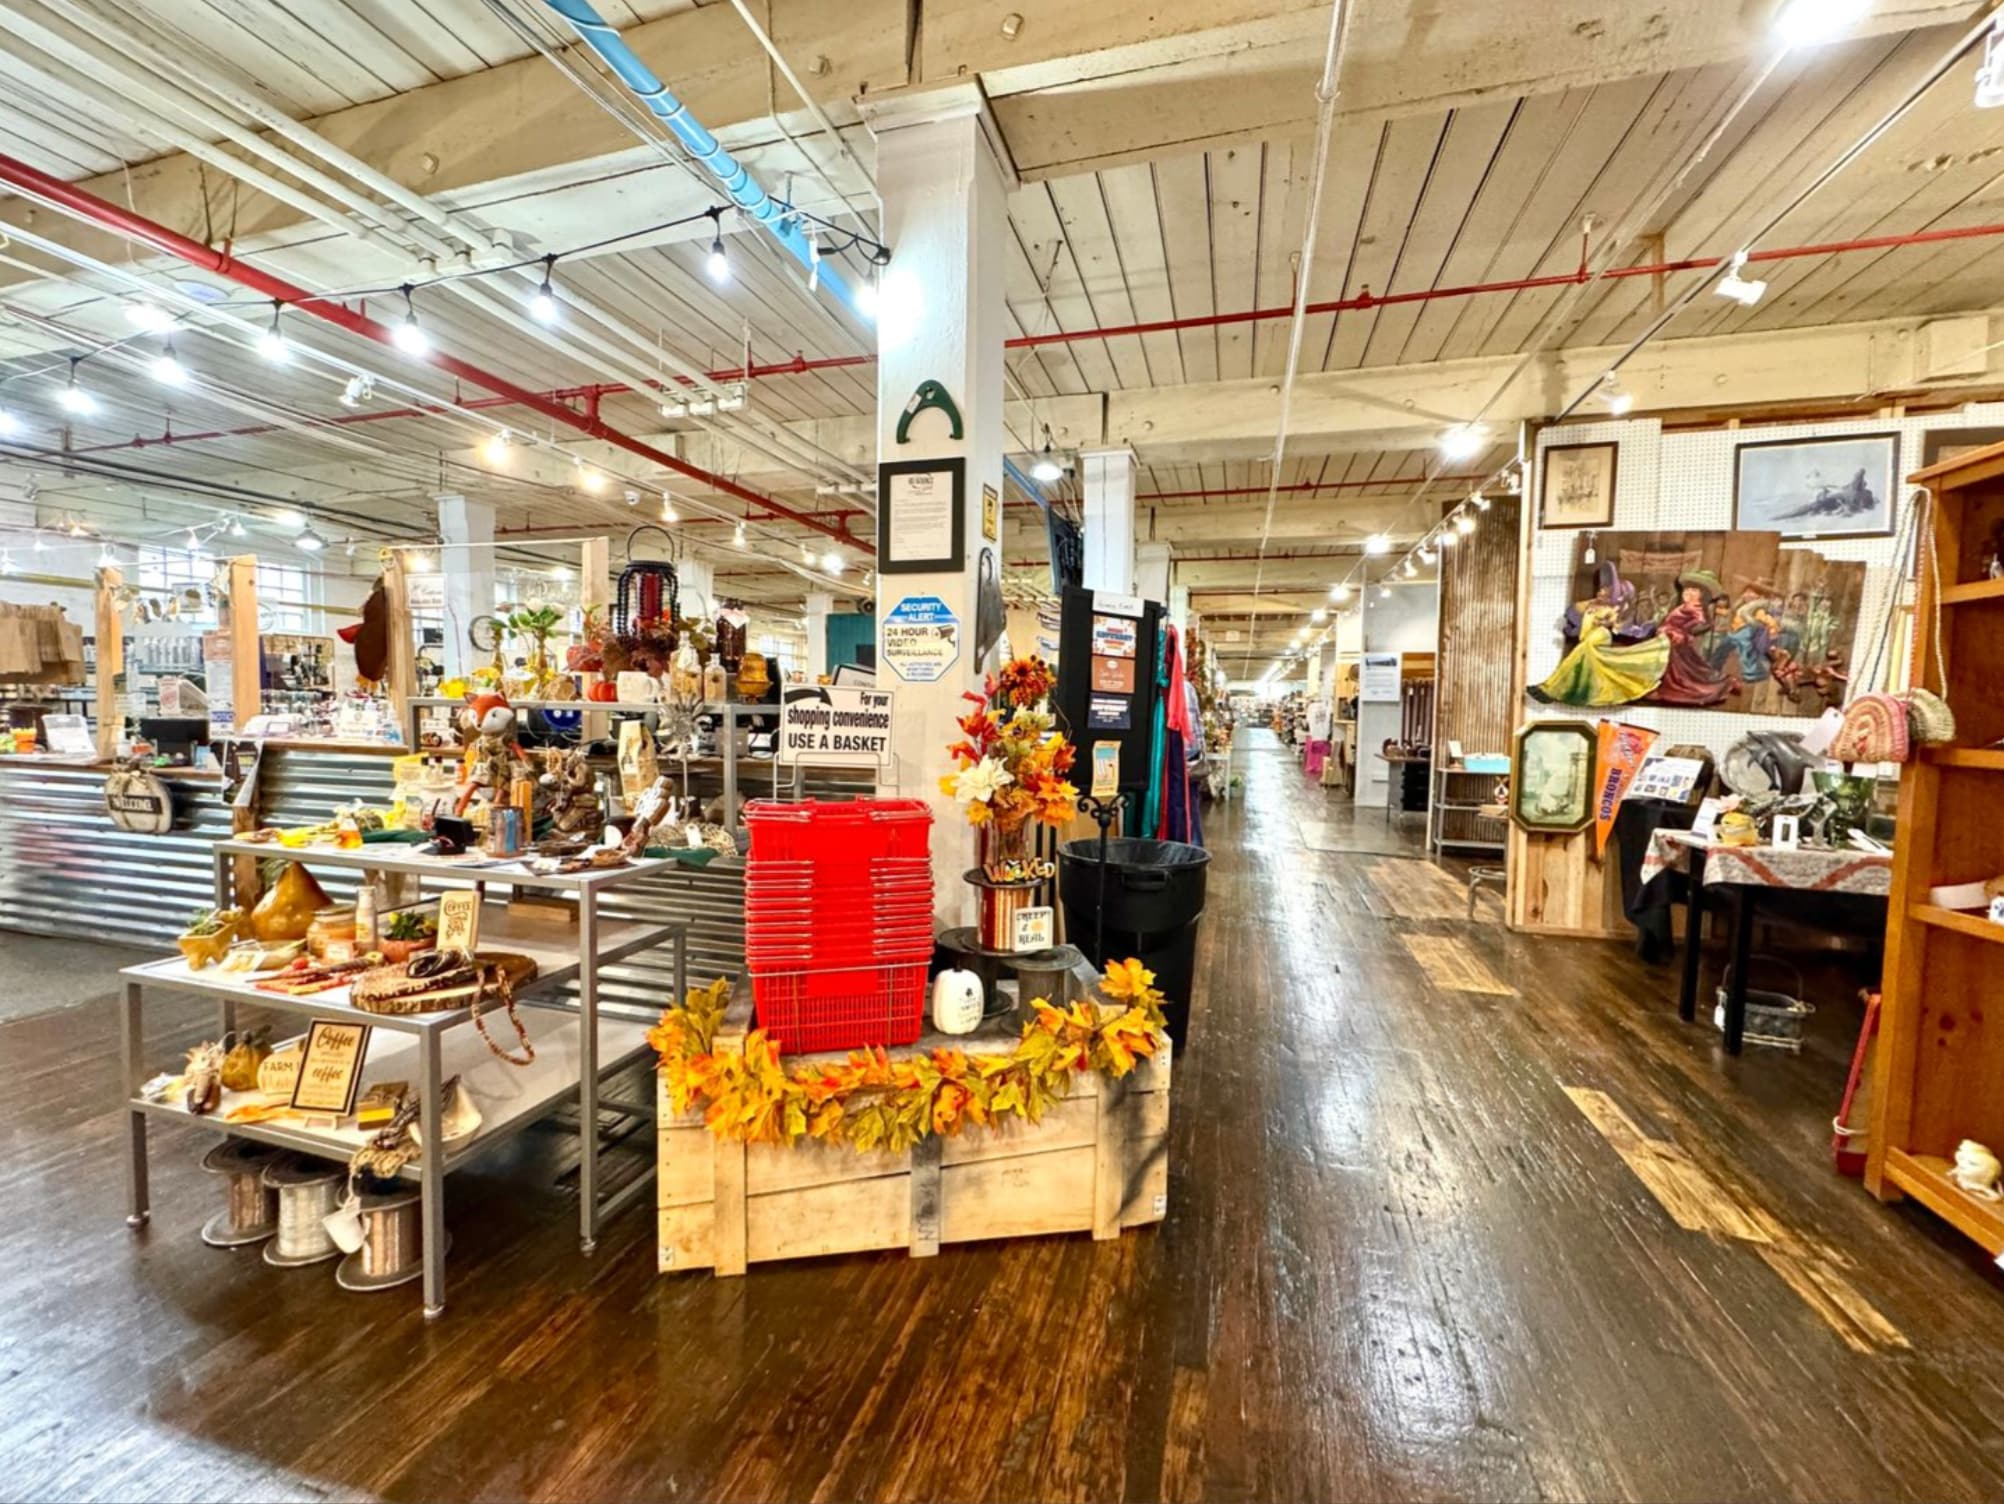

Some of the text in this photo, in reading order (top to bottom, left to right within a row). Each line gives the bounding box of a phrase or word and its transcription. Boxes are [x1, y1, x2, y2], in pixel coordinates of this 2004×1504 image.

[901, 603, 942, 612] SECURITY
[908, 612, 936, 621] ALERT
[887, 627, 929, 637] 24 HOUR
[887, 638, 917, 647] VIDEO
[887, 649, 944, 657] SURVEILLANCE
[860, 691, 889, 708] For your
[788, 705, 889, 730] shopping convenience
[788, 733, 887, 752] USE A BASKET
[1599, 767, 1622, 820] BRONCOS
[316, 1026, 354, 1050] Coffee
[263, 1061, 293, 1072] FARM
[312, 1065, 344, 1082] coffee
